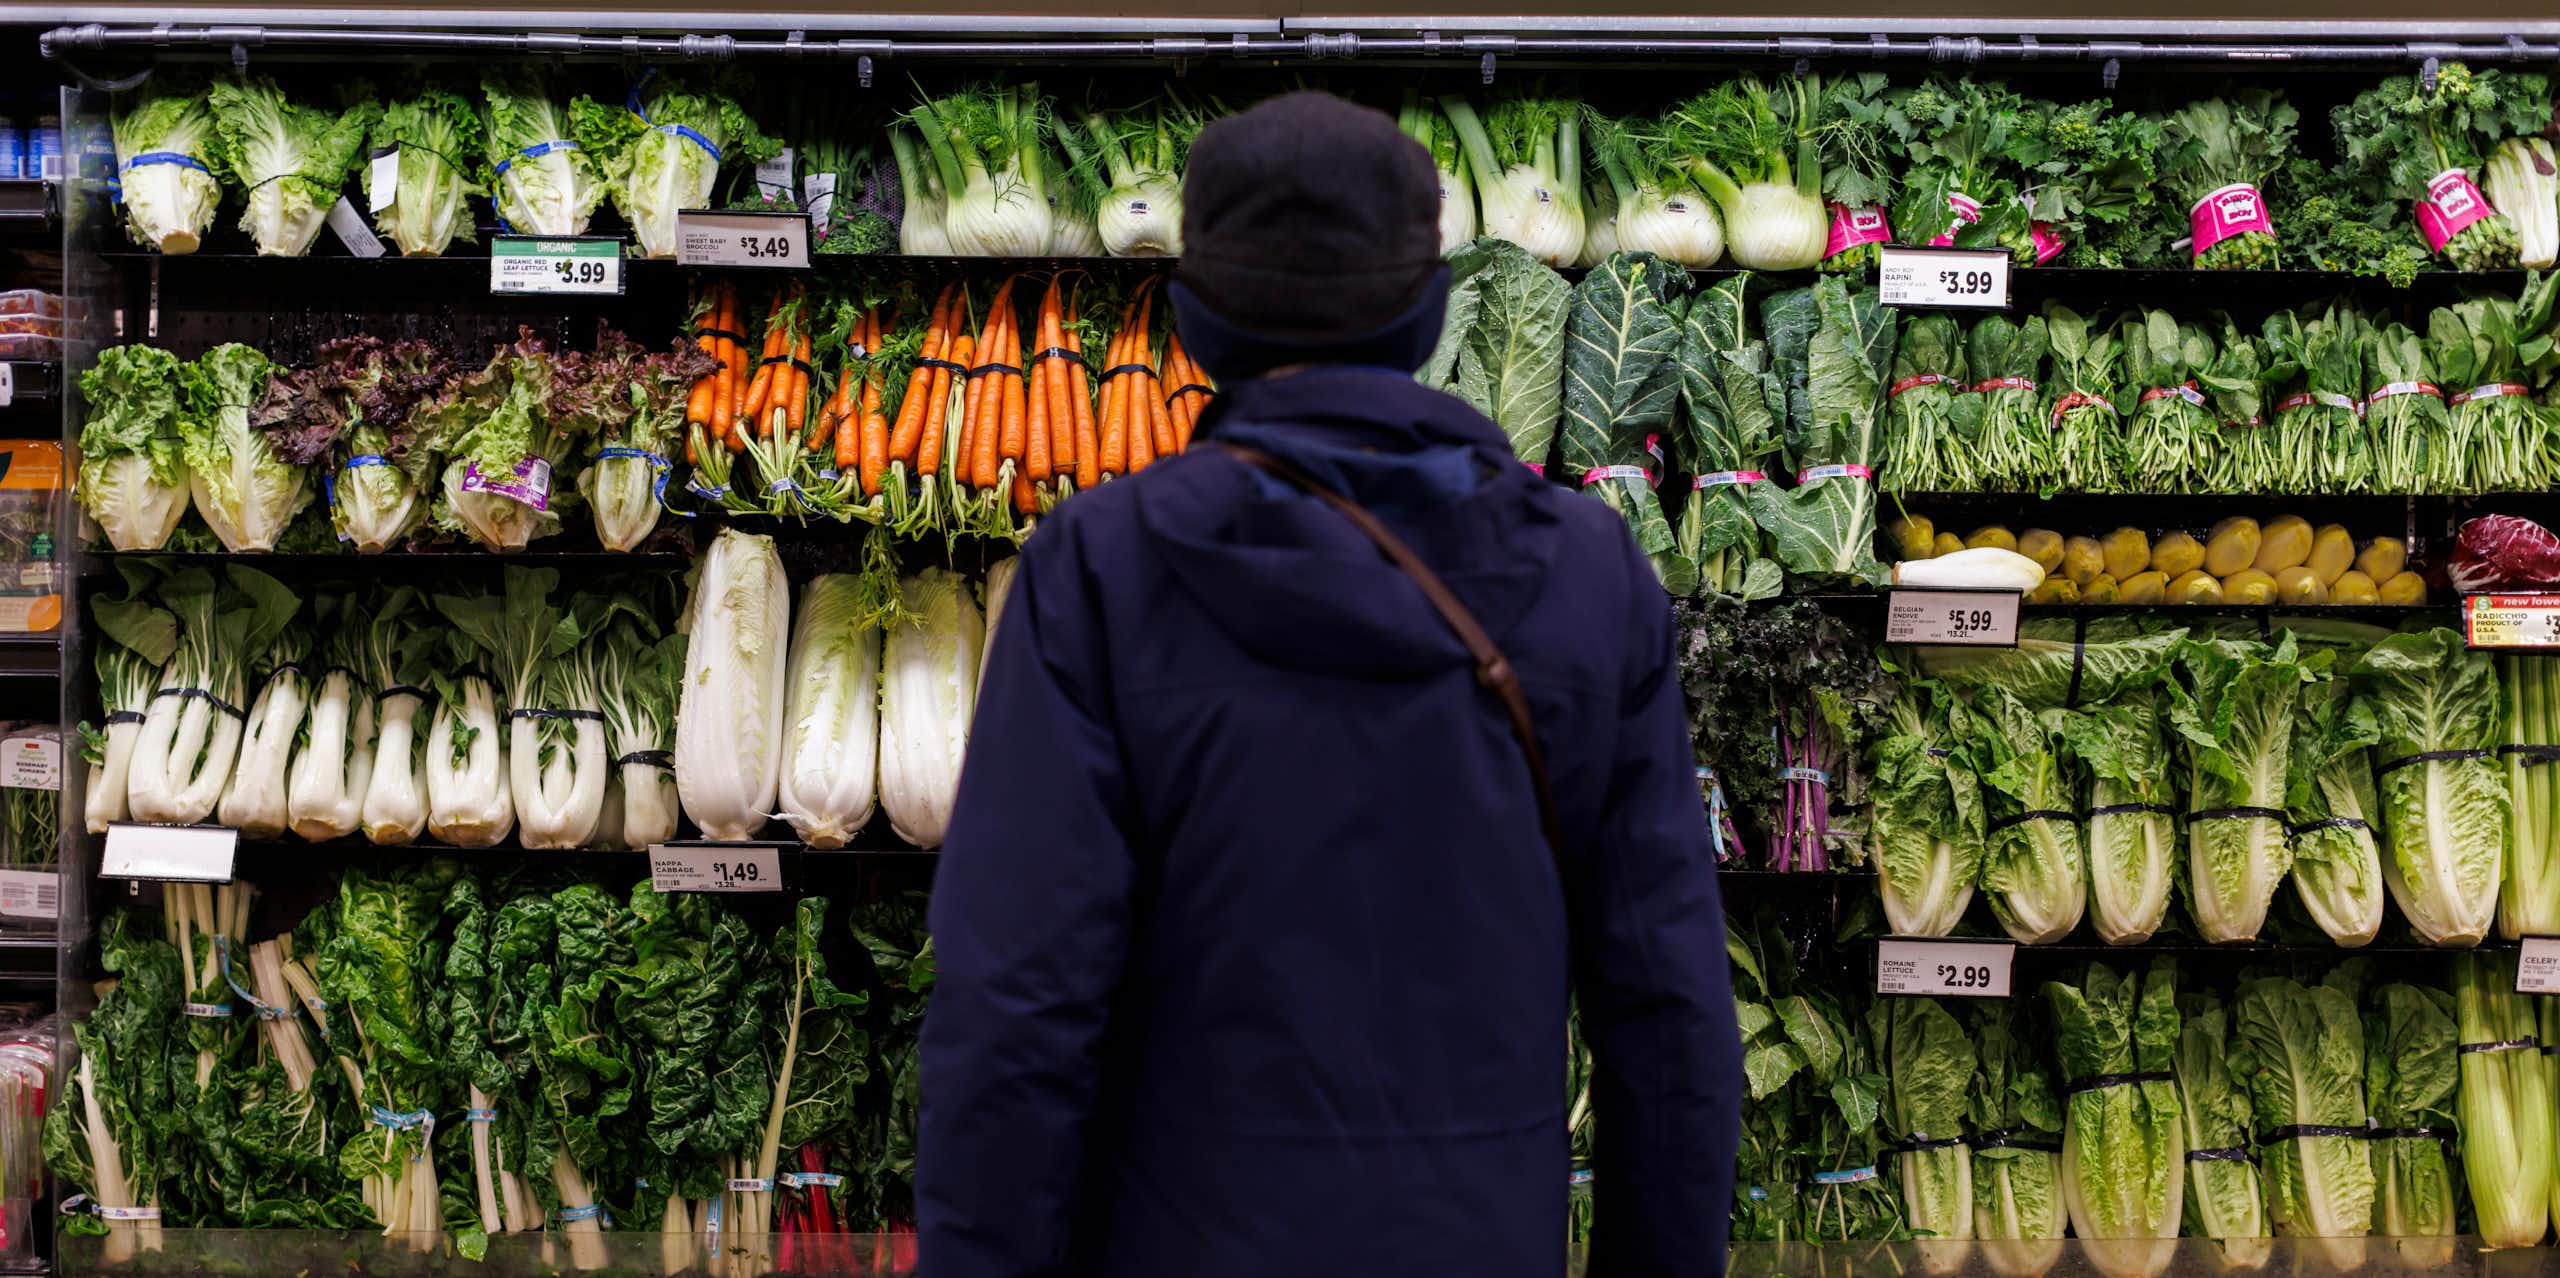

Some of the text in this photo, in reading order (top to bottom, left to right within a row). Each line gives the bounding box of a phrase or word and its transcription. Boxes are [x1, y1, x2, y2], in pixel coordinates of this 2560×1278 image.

[2221, 194, 2253, 207] ANDY
[1857, 215, 1877, 226] BOY
[2229, 209, 2252, 220] BOY
[537, 242, 577, 253] ORGANIC
[740, 236, 790, 258] $3.49
[555, 260, 605, 284] $3.99
[1940, 270, 1993, 294] $3.99
[2503, 596, 2560, 606] new lowe
[1893, 606, 1924, 614] BELGIAN
[2475, 612, 2528, 620] RADICCHIO
[1948, 609, 1992, 632] $5.99
[713, 862, 758, 881] $1.49
[2525, 956, 2559, 965] CELERY
[1937, 964, 1991, 988] $2.99
